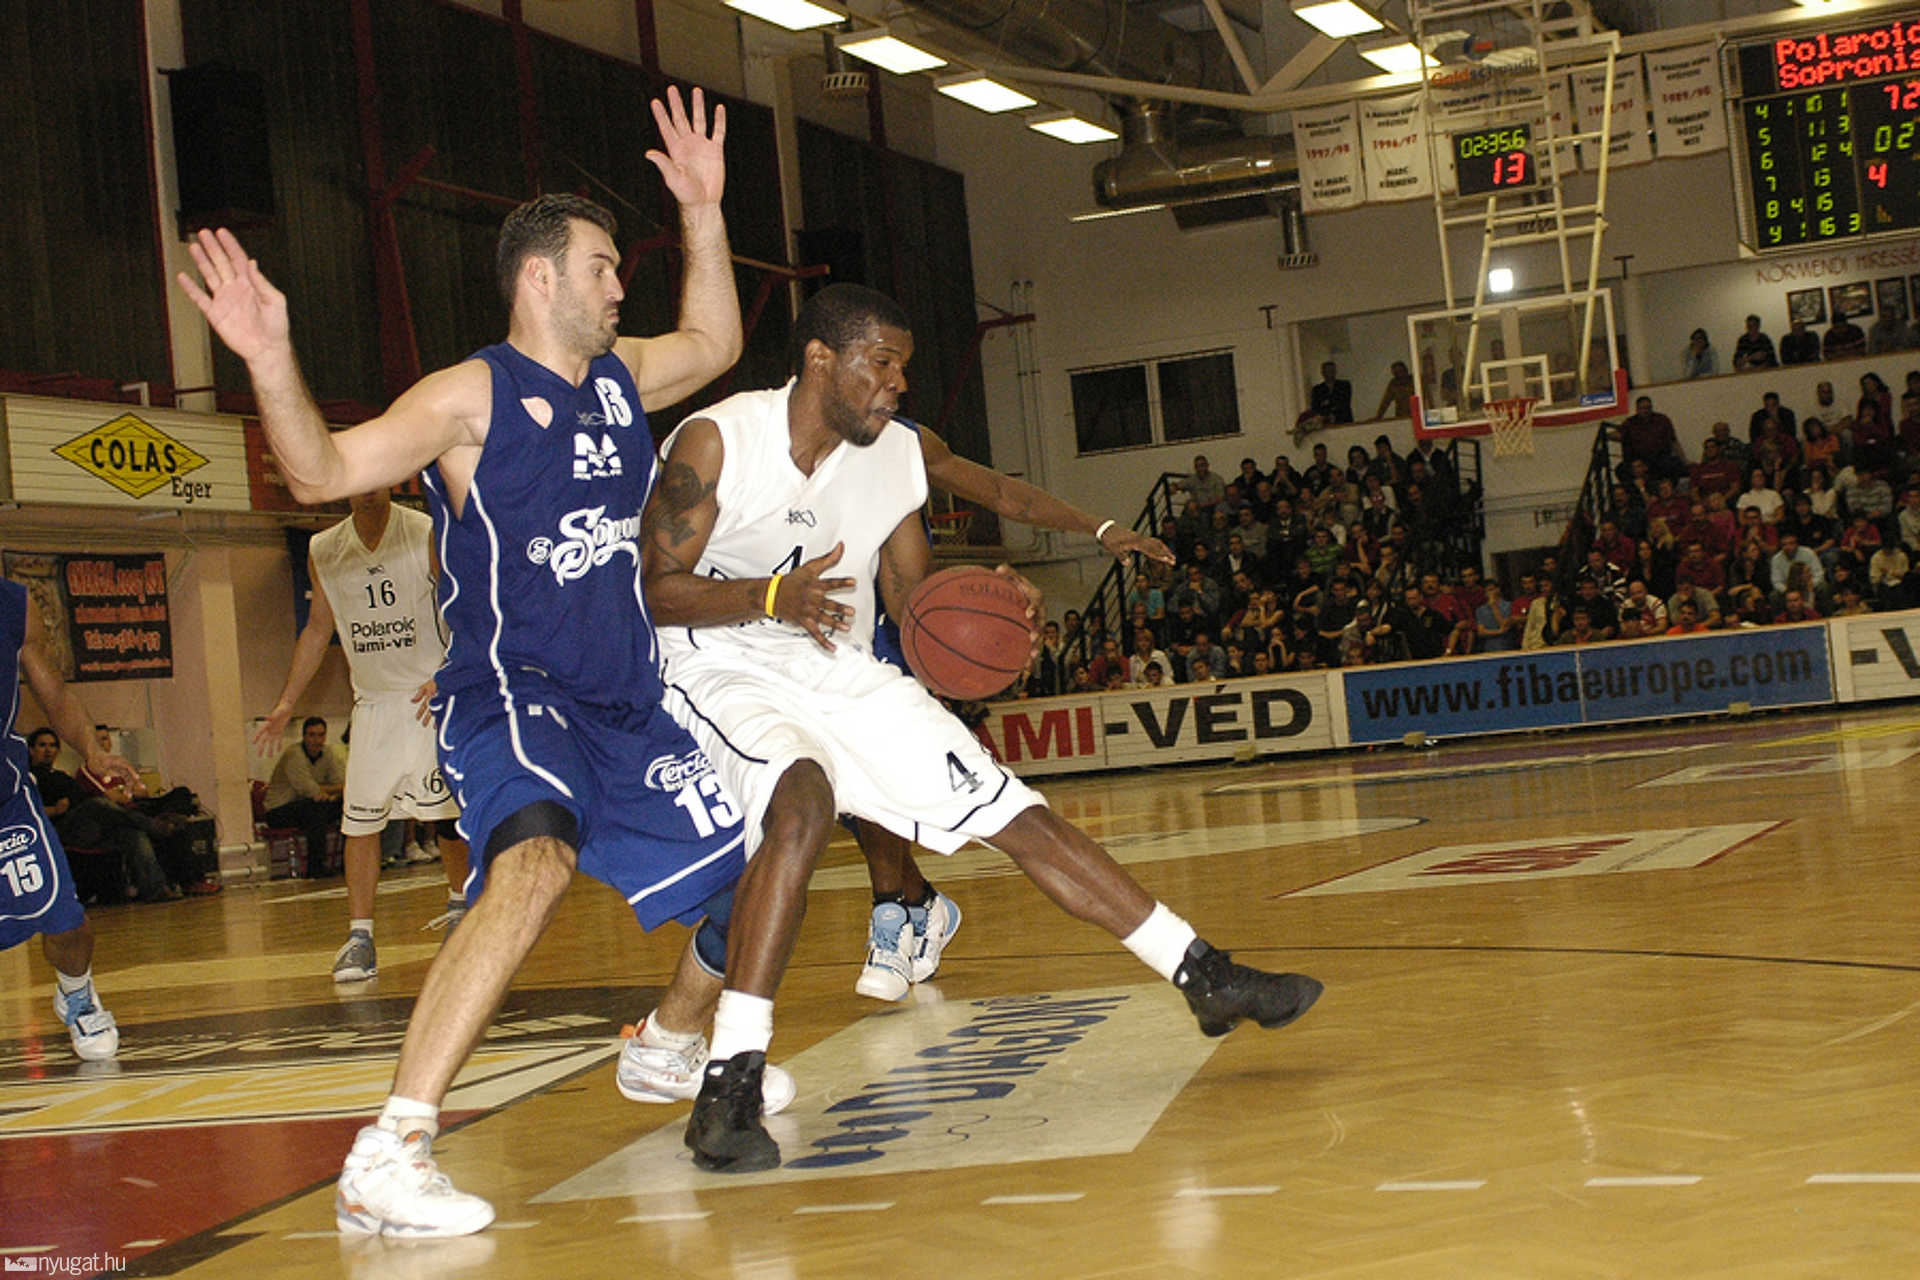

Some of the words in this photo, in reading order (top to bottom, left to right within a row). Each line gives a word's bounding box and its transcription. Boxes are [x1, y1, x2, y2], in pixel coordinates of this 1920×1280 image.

[1758, 127, 1772, 146] 5
[1493, 152, 1526, 184] 13
[1761, 151, 1774, 170] 6
[1765, 176, 1777, 192] 7
[1867, 162, 1888, 189] 4
[1766, 200, 1780, 219] 8
[90, 438, 178, 474] COLAS
[171, 475, 212, 503] Eger
[365, 580, 396, 609] 16
[1362, 649, 1812, 720] www.fibaeurope.com
[946, 750, 984, 794] 4
[673, 774, 744, 838] 13
[0, 854, 43, 897] 15
